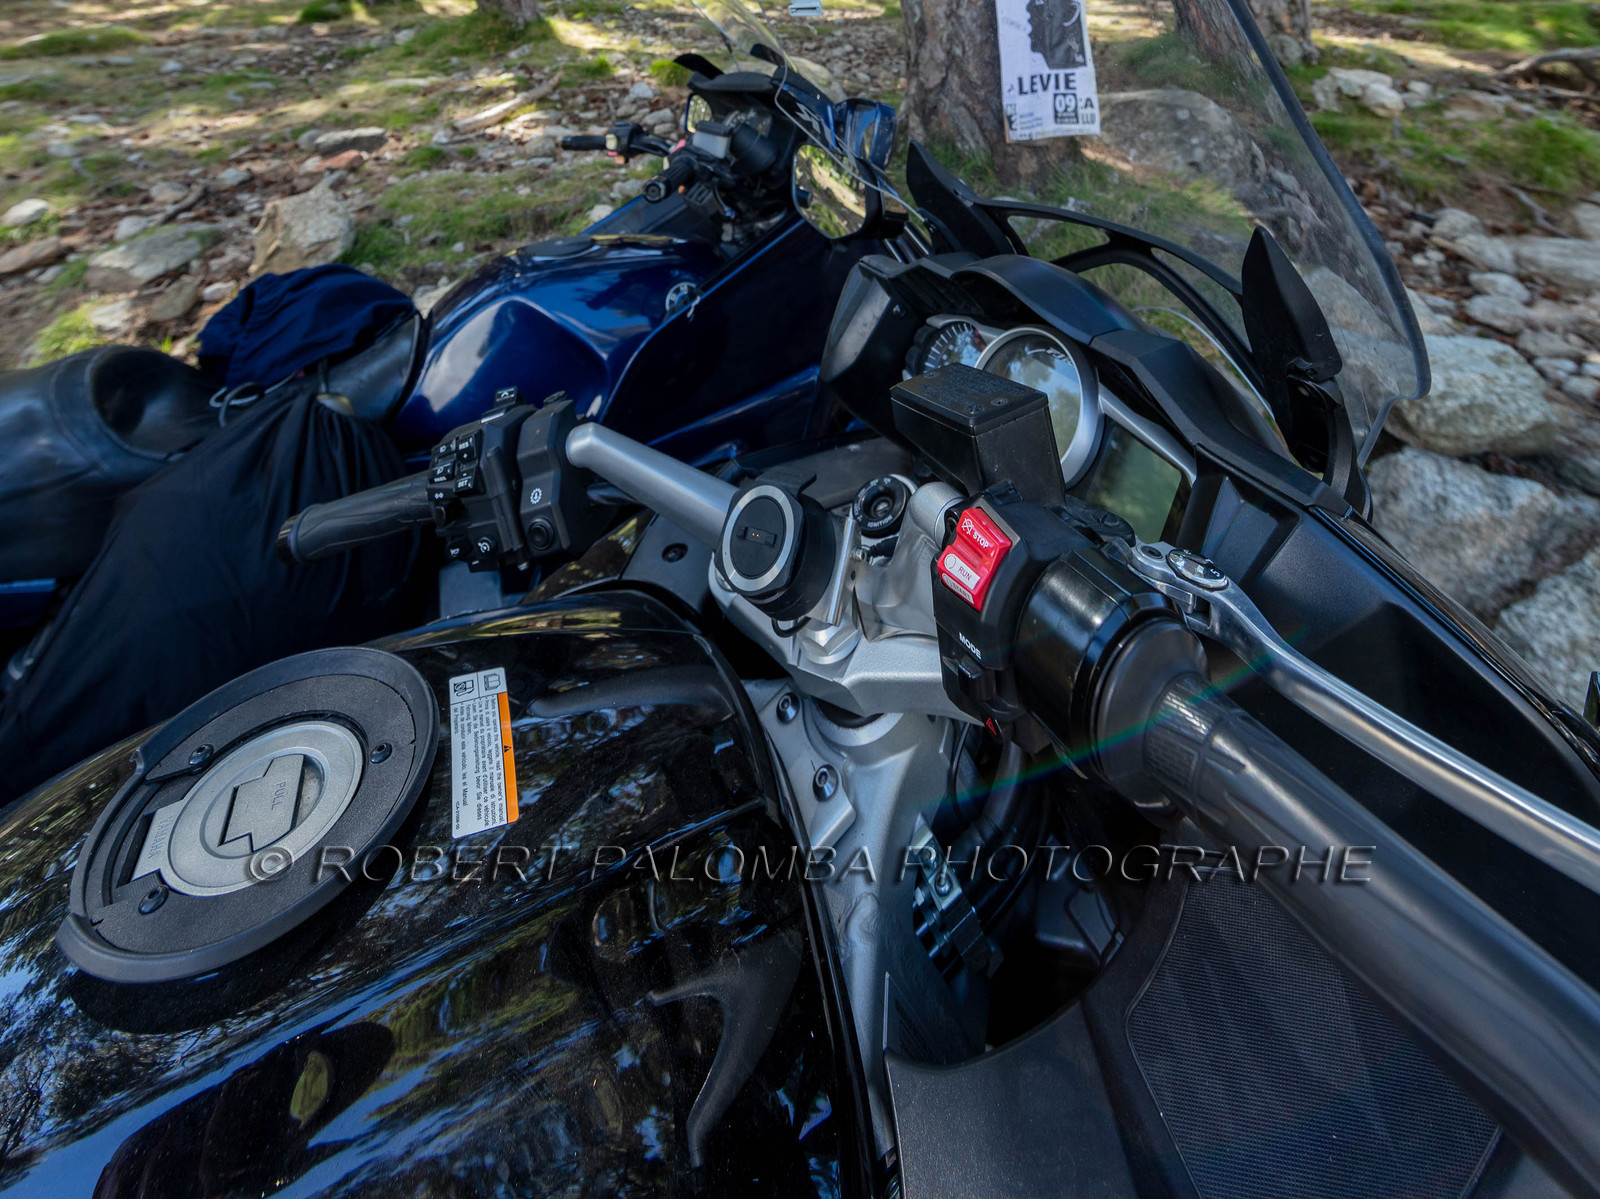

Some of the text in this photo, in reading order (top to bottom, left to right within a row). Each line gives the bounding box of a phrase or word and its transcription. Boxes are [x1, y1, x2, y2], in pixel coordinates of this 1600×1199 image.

[1018, 73, 1077, 95] LEVIE
[1055, 94, 1076, 112] 09
[457, 479, 468, 488] SET
[867, 514, 893, 528] IGNITION
[972, 531, 989, 549] STOP
[957, 566, 972, 582] RUN
[959, 632, 982, 660] MODE
[271, 781, 287, 811] PULL
